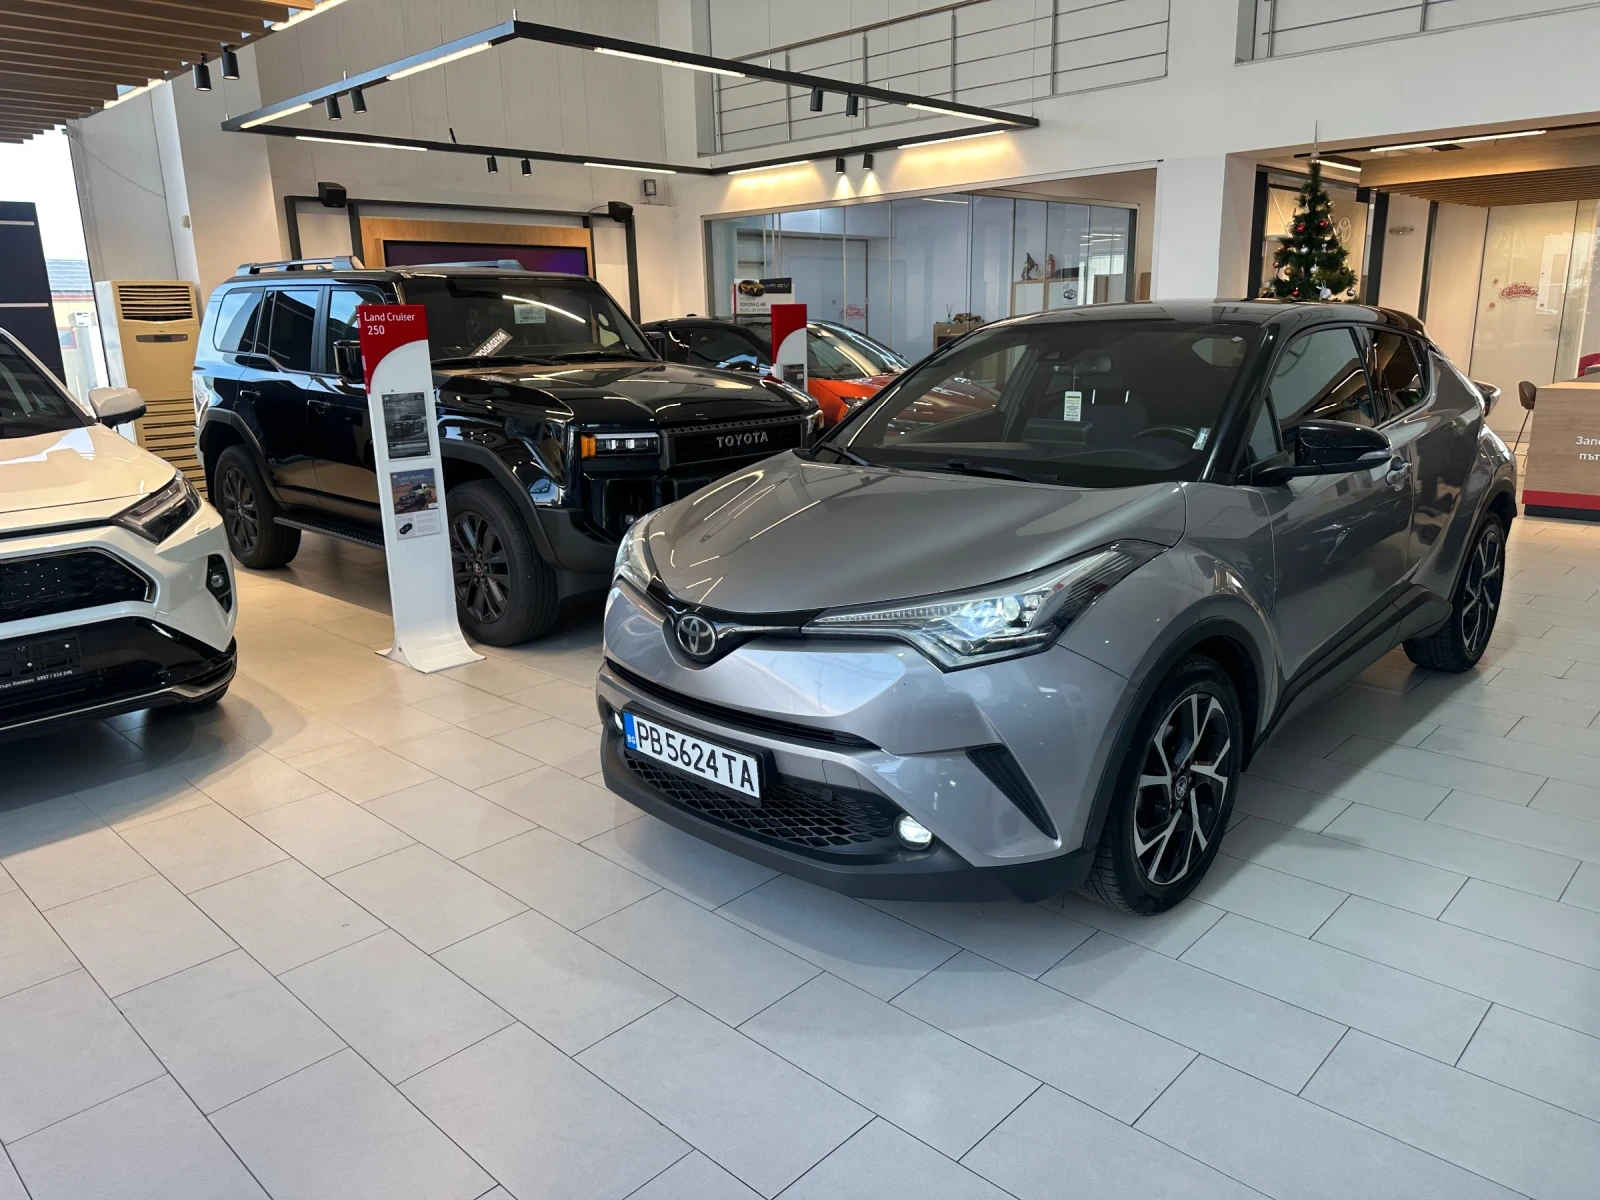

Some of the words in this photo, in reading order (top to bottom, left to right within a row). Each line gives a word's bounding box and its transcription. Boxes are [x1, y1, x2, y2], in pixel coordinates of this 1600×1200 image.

[363, 311, 386, 322] Land
[386, 312, 416, 322] Cruiser
[367, 324, 385, 335] 250
[716, 431, 769, 448] TOYOTA
[1575, 435, 1600, 446] Зап
[627, 734, 636, 744] BG
